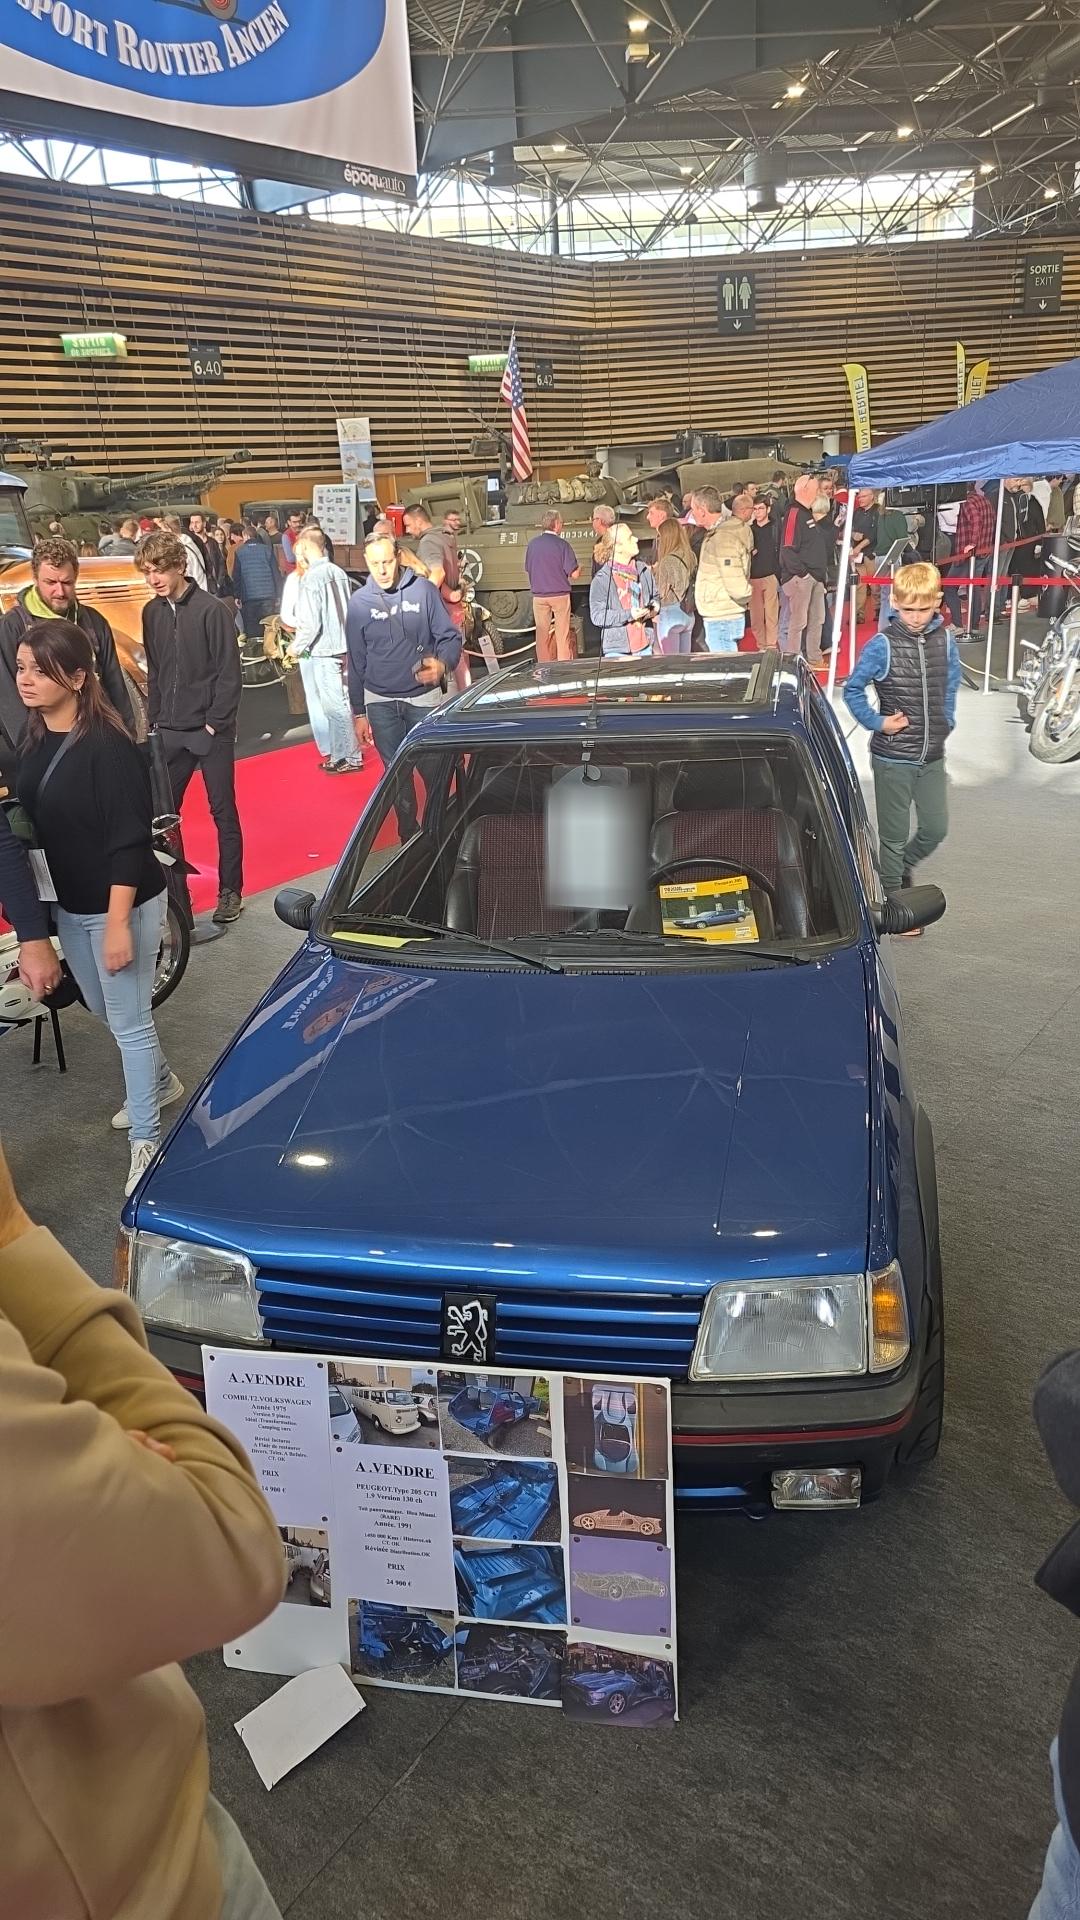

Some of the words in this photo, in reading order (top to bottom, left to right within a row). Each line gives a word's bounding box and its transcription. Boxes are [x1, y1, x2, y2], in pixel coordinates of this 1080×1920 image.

[114, 20, 224, 76] ROUTIER
[220, 0, 290, 68] ANCIEN
[344, 163, 405, 192] époquauto
[1030, 264, 1060, 275] SORTIE
[1035, 276, 1053, 286] EXIT
[194, 360, 221, 376] 6.40
[537, 374, 553, 386] 6.42
[228, 1372, 238, 1383] A
[273, 1404, 287, 1412] 1975
[355, 1461, 366, 1473] A
[262, 1469, 280, 1477] PRIX
[377, 1493, 401, 1502] Version
[423, 1489, 437, 1497] GTI
[387, 1562, 406, 1571] PRIX
[395, 1579, 407, 1587] 900
